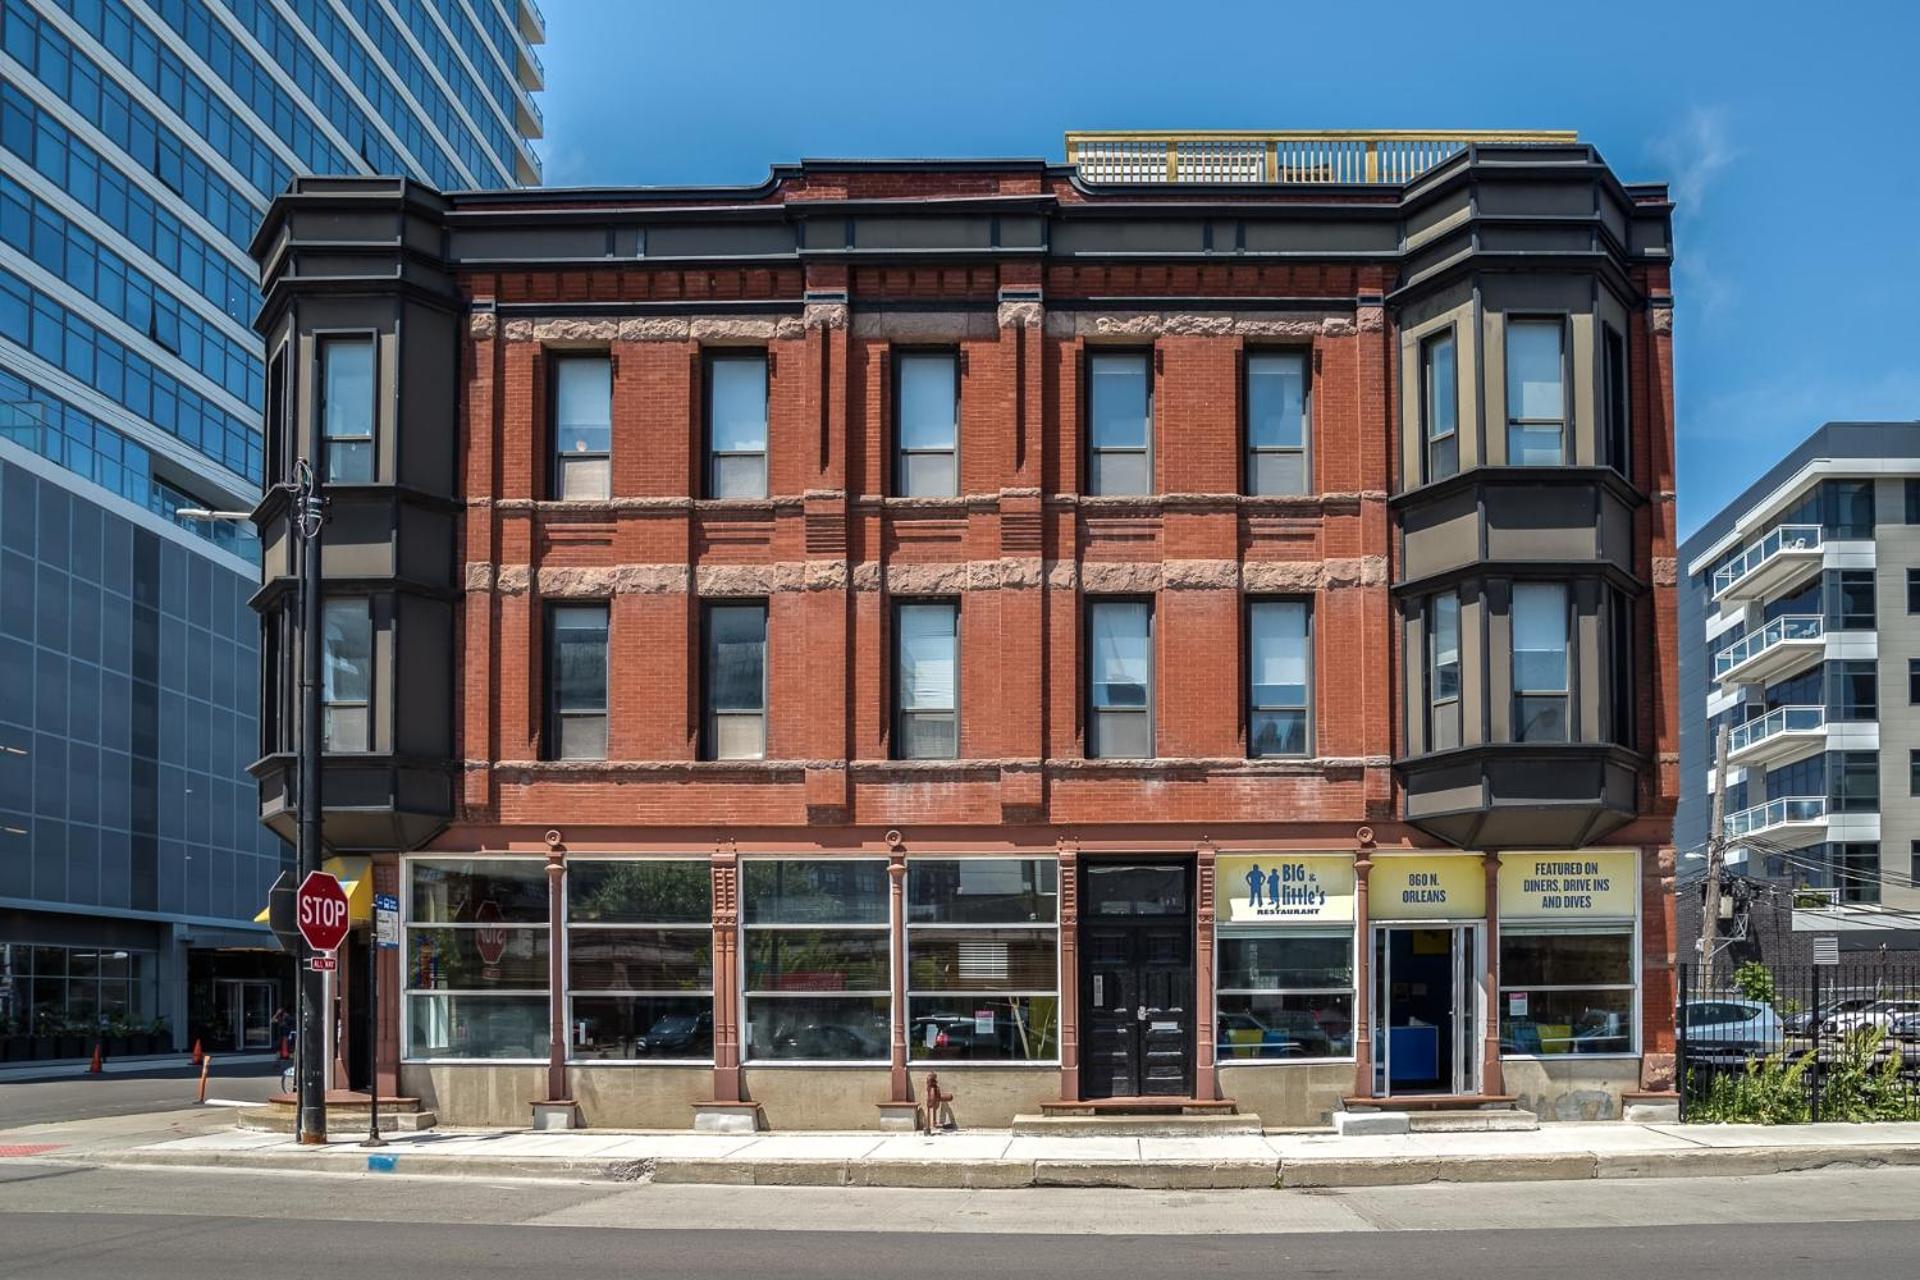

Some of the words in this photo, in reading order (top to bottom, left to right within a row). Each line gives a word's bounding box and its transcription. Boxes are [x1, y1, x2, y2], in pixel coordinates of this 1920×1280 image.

[1282, 864, 1305, 882] BIG
[1308, 873, 1316, 882] &
[1535, 862, 1583, 875] FEATURED
[1584, 862, 1598, 875] ON
[1408, 873, 1428, 887] 860
[1430, 873, 1440, 887] N.
[1523, 879, 1561, 893] DINERS,
[1563, 879, 1592, 892] DRIVE
[1593, 879, 1610, 892] INS
[1282, 884, 1326, 906] little's
[1402, 890, 1446, 903] ORLEANS
[1542, 895, 1561, 909] AND
[1563, 895, 1592, 909] DIVES
[301, 895, 346, 928] STOP
[1256, 908, 1320, 916] RESTAURANT
